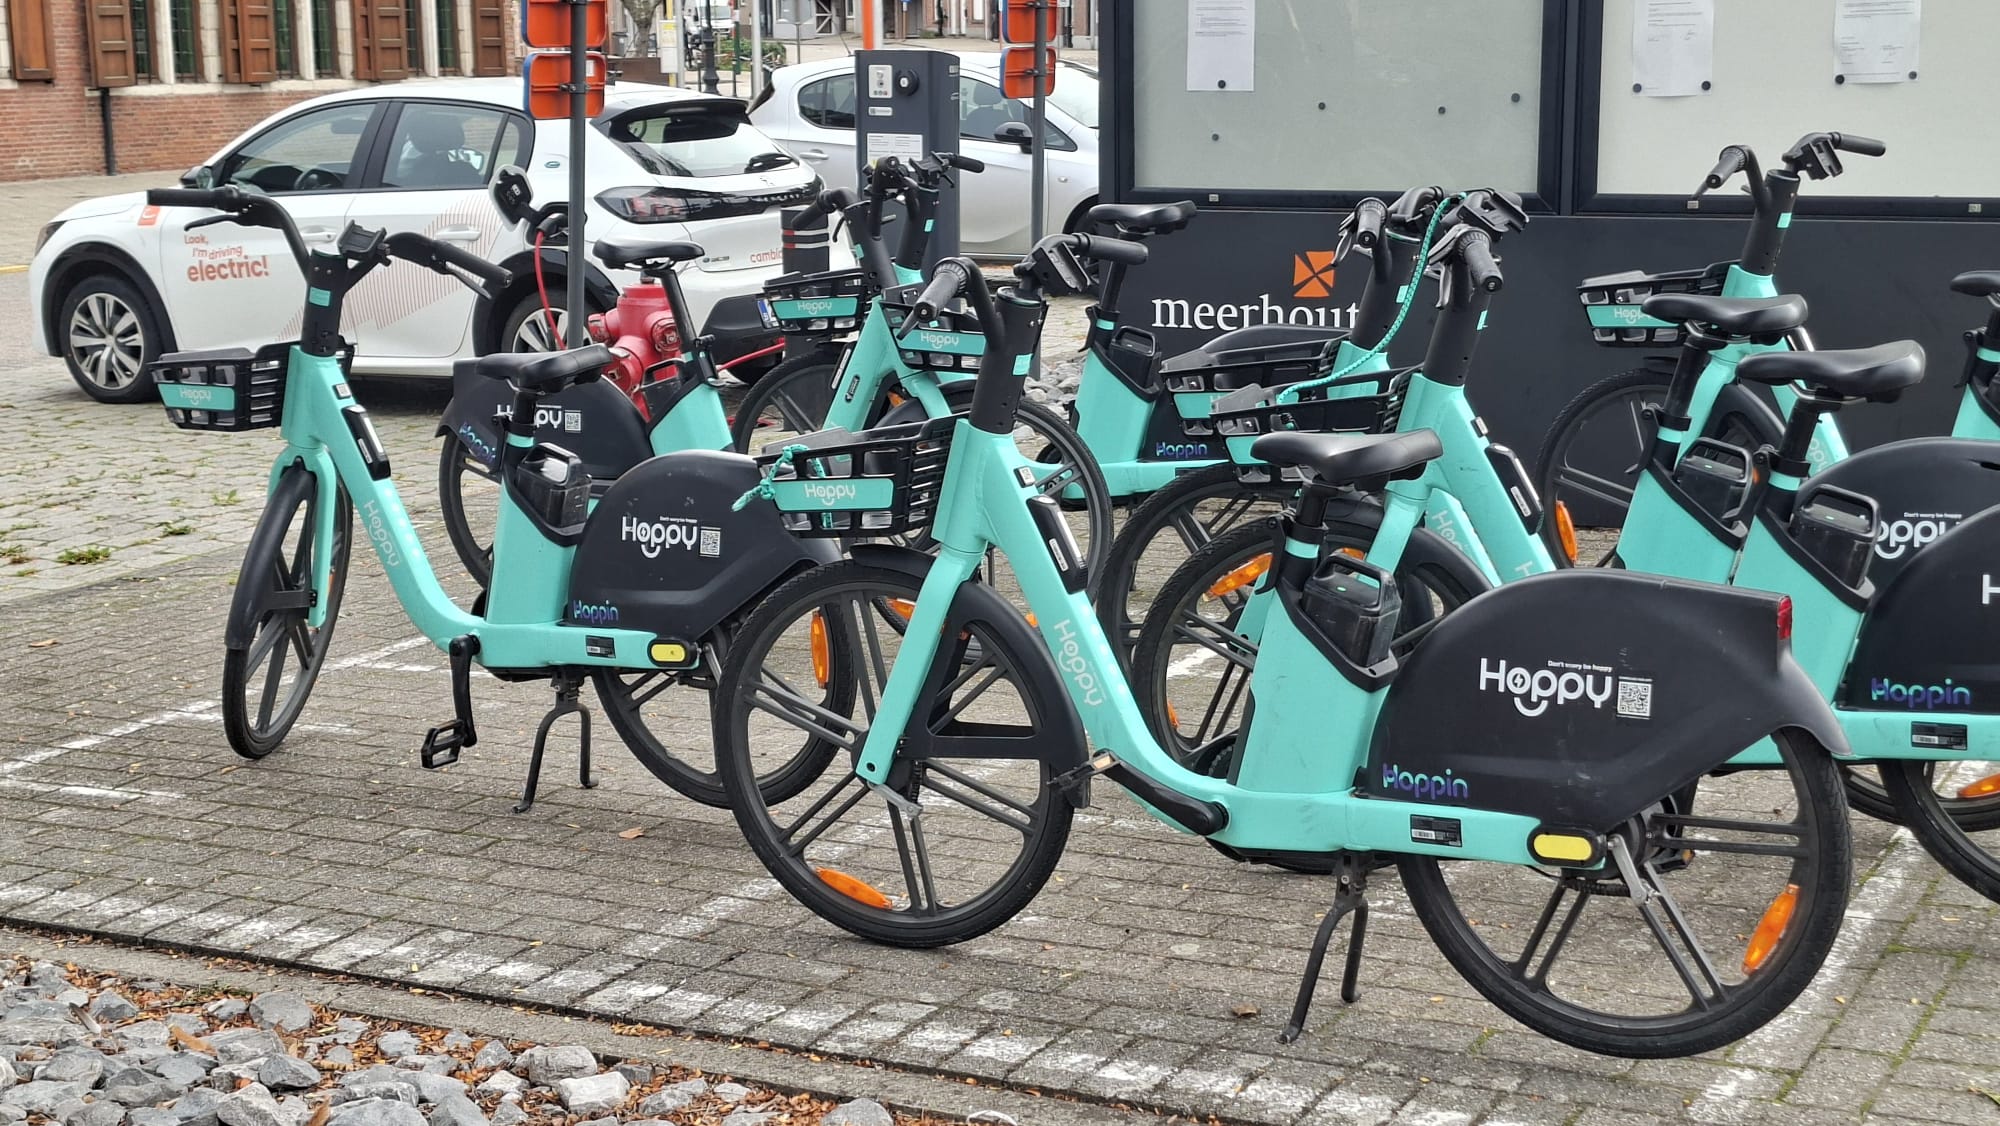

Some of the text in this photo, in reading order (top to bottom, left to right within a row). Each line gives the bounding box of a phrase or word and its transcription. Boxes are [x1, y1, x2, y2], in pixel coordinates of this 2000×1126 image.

[184, 234, 209, 245] Look,
[192, 246, 242, 260] I'm driving
[186, 255, 269, 282] electric!
[797, 301, 833, 314] Hoppy
[1151, 293, 1360, 331] meerhout
[920, 331, 960, 348] Hoppy
[180, 387, 212, 405] Hoppy
[1155, 441, 1208, 459] Hoppin
[804, 483, 857, 506] Hoppy
[363, 499, 399, 567] Hoppy
[621, 516, 698, 558] Hoppy
[573, 599, 619, 624] Hoppin
[1054, 619, 1103, 706] Hoppy
[1479, 657, 1613, 717] Hoppy
[1871, 677, 1971, 709] Hoppin
[1382, 763, 1468, 800] Hoppin
